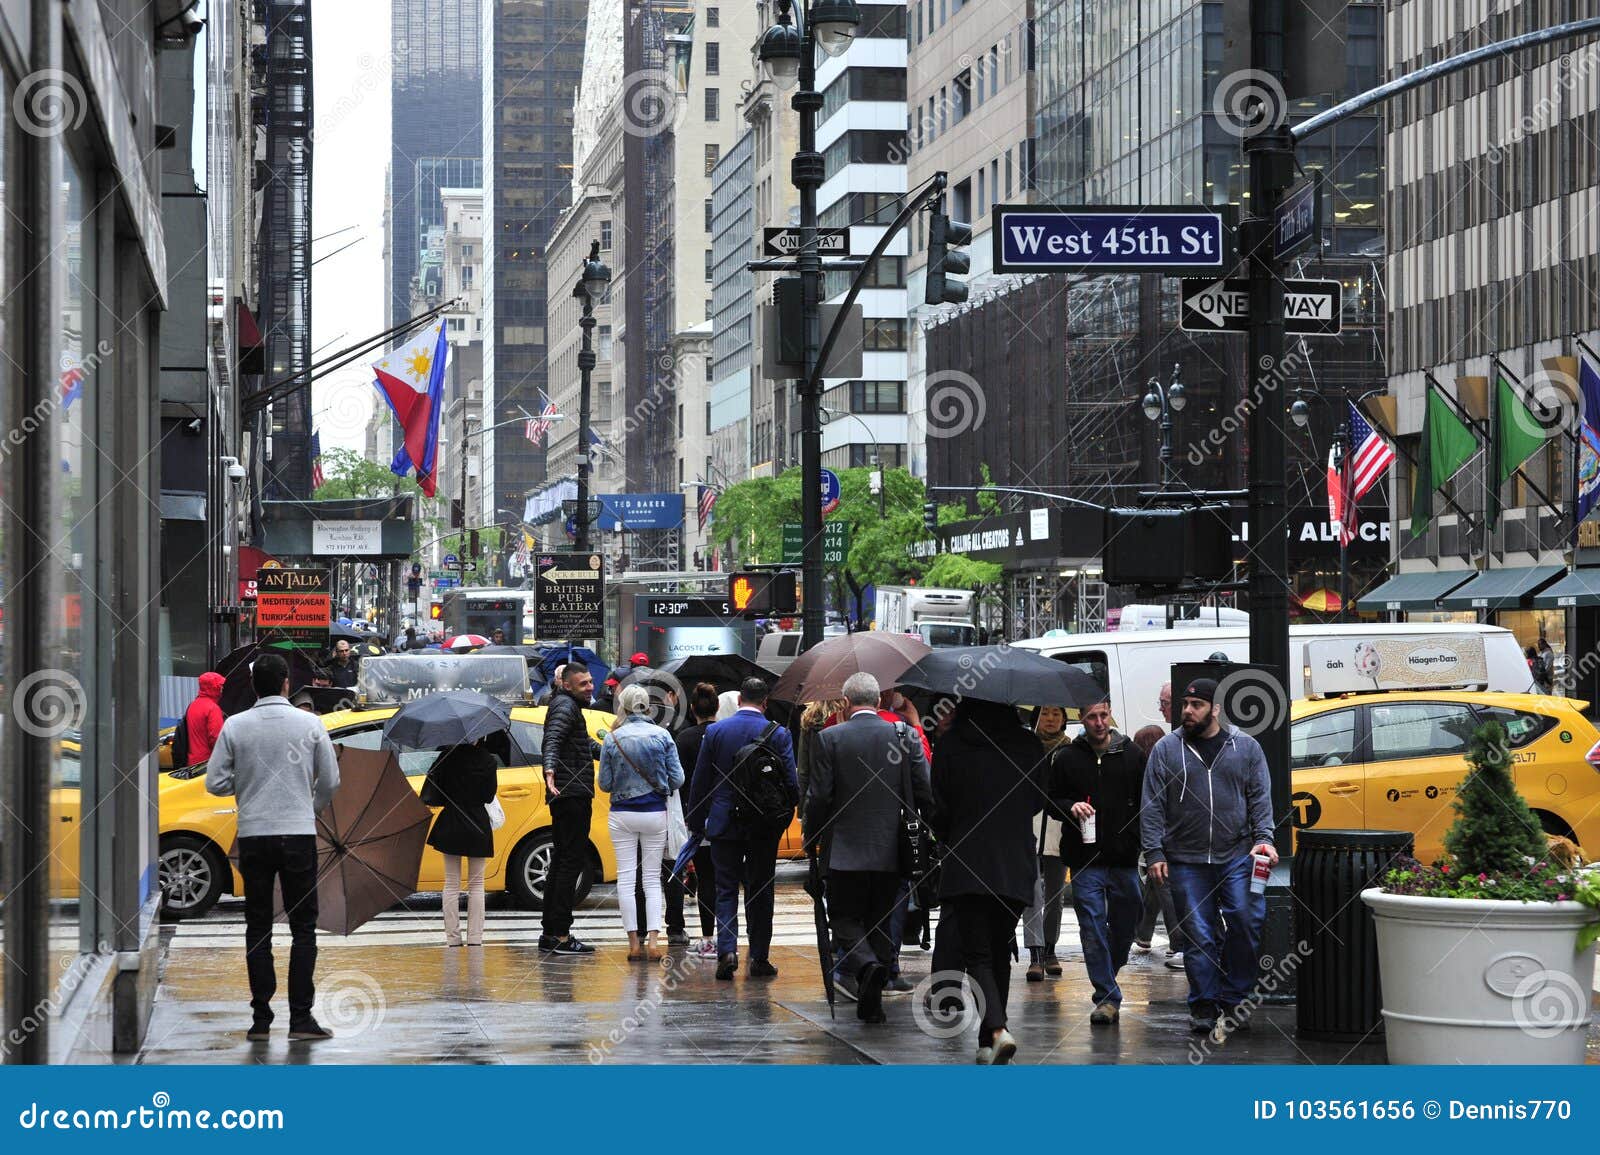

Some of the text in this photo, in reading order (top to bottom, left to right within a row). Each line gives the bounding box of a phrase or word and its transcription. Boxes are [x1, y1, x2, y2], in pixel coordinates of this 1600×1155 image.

[1010, 225, 1214, 255] West 45th St
[1199, 293, 1249, 314] ONE
[637, 500, 665, 508] BAKER
[825, 522, 843, 534] x12
[824, 537, 842, 548] x14
[824, 551, 842, 562] x30
[544, 585, 595, 593] BRITISH
[262, 598, 326, 606] MEDITERRANEAN
[558, 594, 583, 602] PUB
[540, 602, 600, 611] & EATERY
[295, 614, 326, 622] CUISINE
